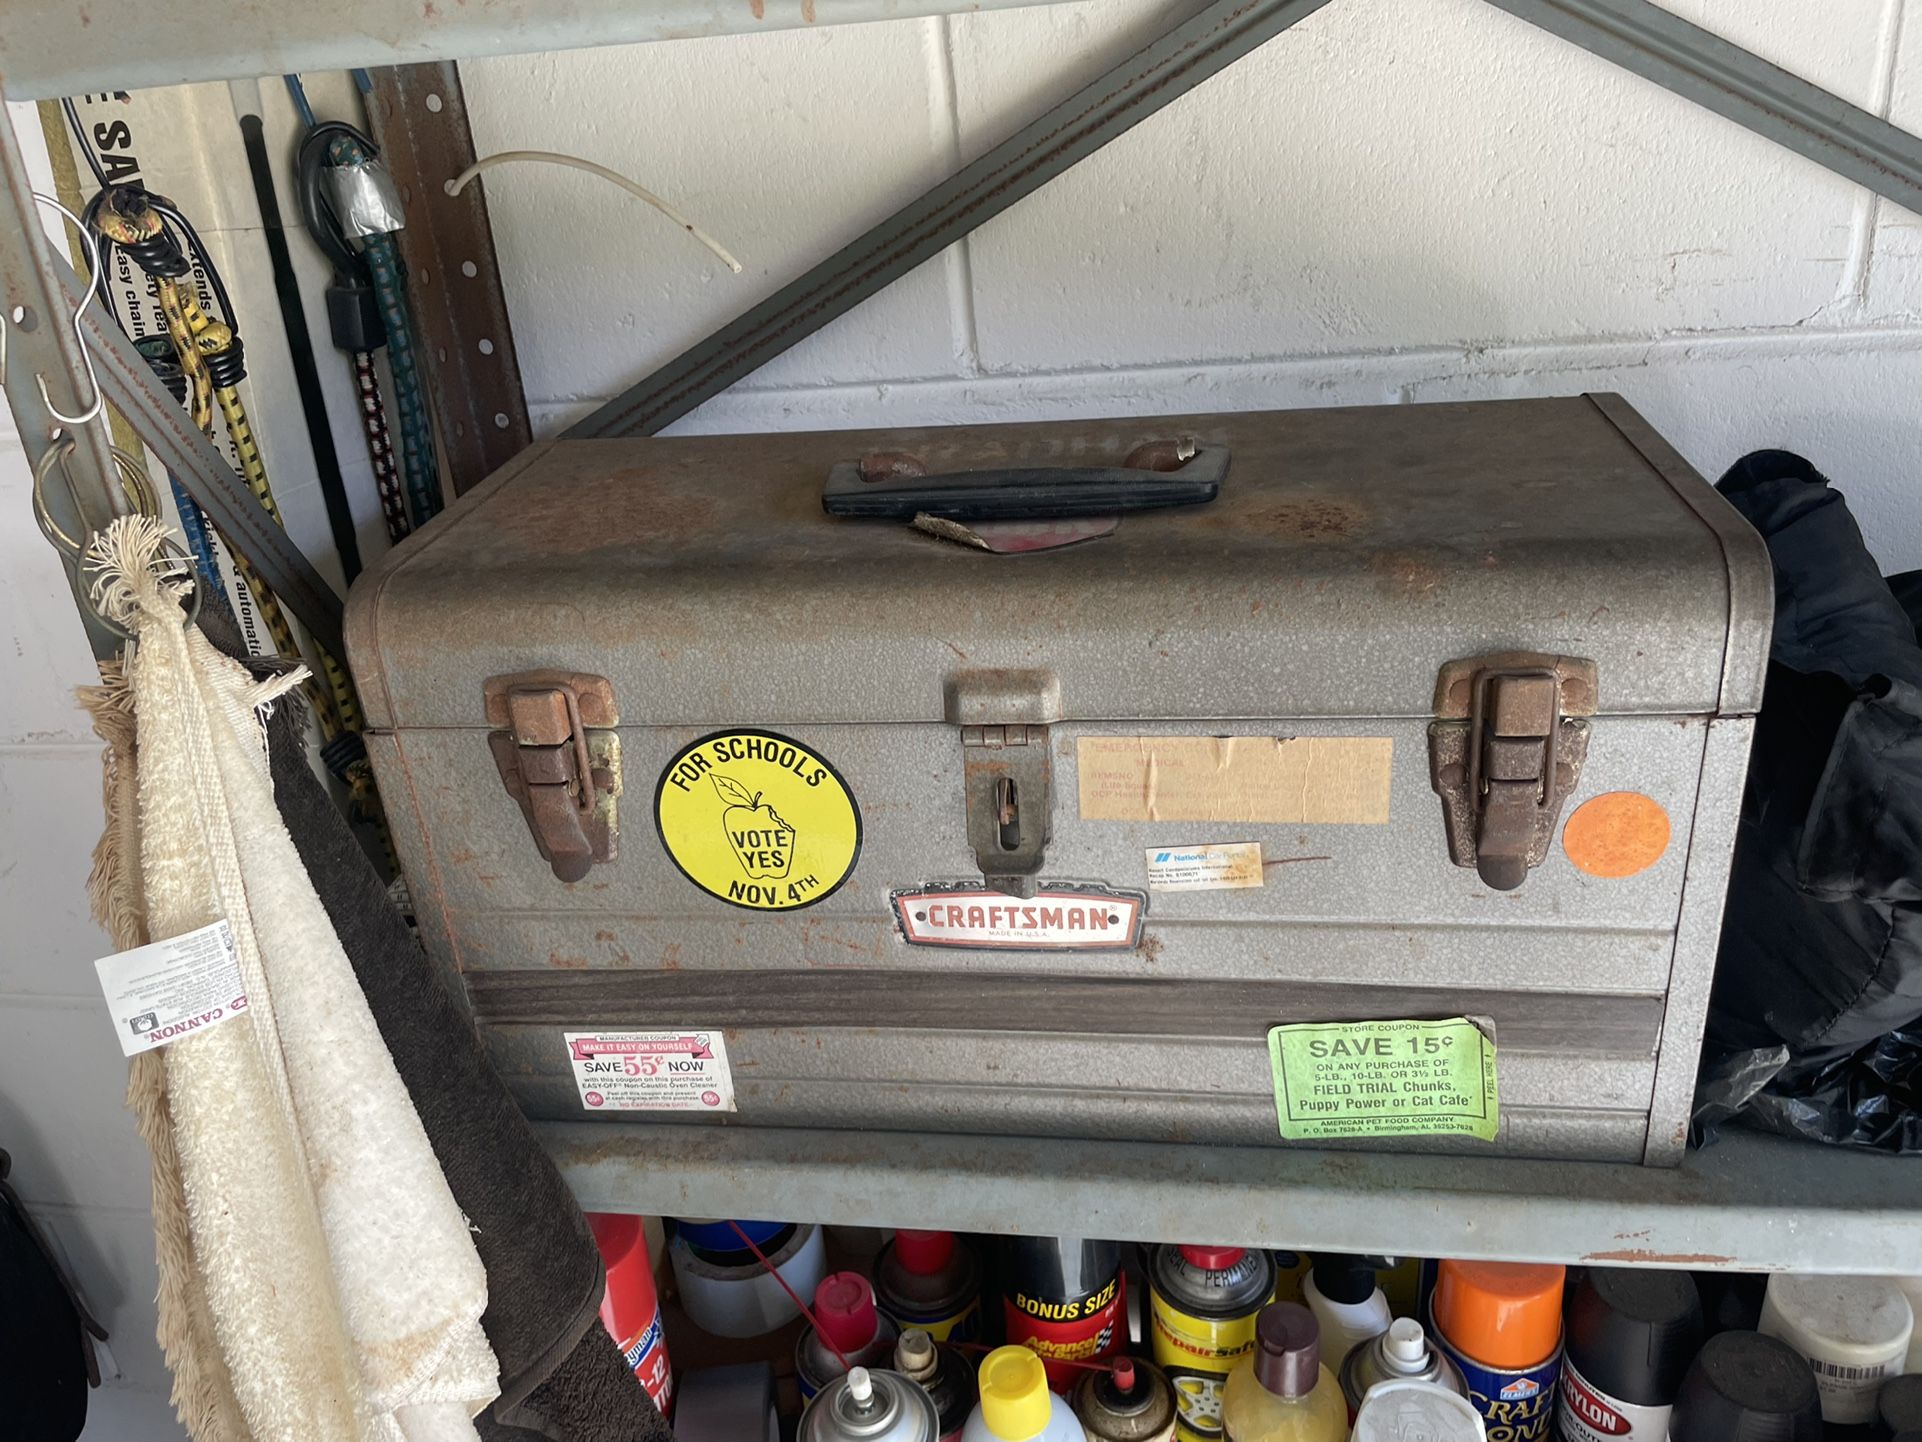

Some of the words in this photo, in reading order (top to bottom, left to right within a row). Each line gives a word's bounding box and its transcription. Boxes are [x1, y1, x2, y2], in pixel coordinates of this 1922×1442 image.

[125, 290, 146, 337] chain
[670, 751, 713, 792] FOR
[713, 738, 828, 788] SCHOOLS
[732, 829, 788, 848] VOTE
[743, 850, 785, 869] YES
[1174, 851, 1208, 862] National
[728, 880, 784, 905] NOV.
[787, 874, 820, 902] 4TH
[927, 904, 1109, 930] CRAFTSMAN
[150, 1008, 223, 1042] CANNON
[1342, 1025, 1375, 1033] STORE
[651, 1042, 693, 1050] YOURSELF
[1309, 1037, 1393, 1058] SAVE
[1407, 1036, 1453, 1054] 15¢
[584, 1062, 623, 1073] SAVE
[668, 1061, 704, 1072] NOW
[1316, 1063, 1333, 1071] ON
[1365, 1060, 1430, 1069] PURCHASE
[1433, 1059, 1449, 1067] OF
[1485, 1061, 1493, 1076] HERE
[1352, 1071, 1386, 1080] 10-LB.
[1391, 1070, 1408, 1078] OR
[1314, 1084, 1351, 1095] FIELD
[1357, 1082, 1397, 1093] TRIAL
[1403, 1081, 1457, 1092] Chunks,
[1486, 1080, 1494, 1094] PEEL
[1300, 1100, 1339, 1112] Puppy
[1346, 1098, 1386, 1109] Power
[1393, 1099, 1406, 1108] or
[1412, 1095, 1434, 1106] Cat
[1016, 1293, 1080, 1319] BONUS
[1084, 1279, 1116, 1314] SIZE
[1563, 1374, 1617, 1431] KRYLON
